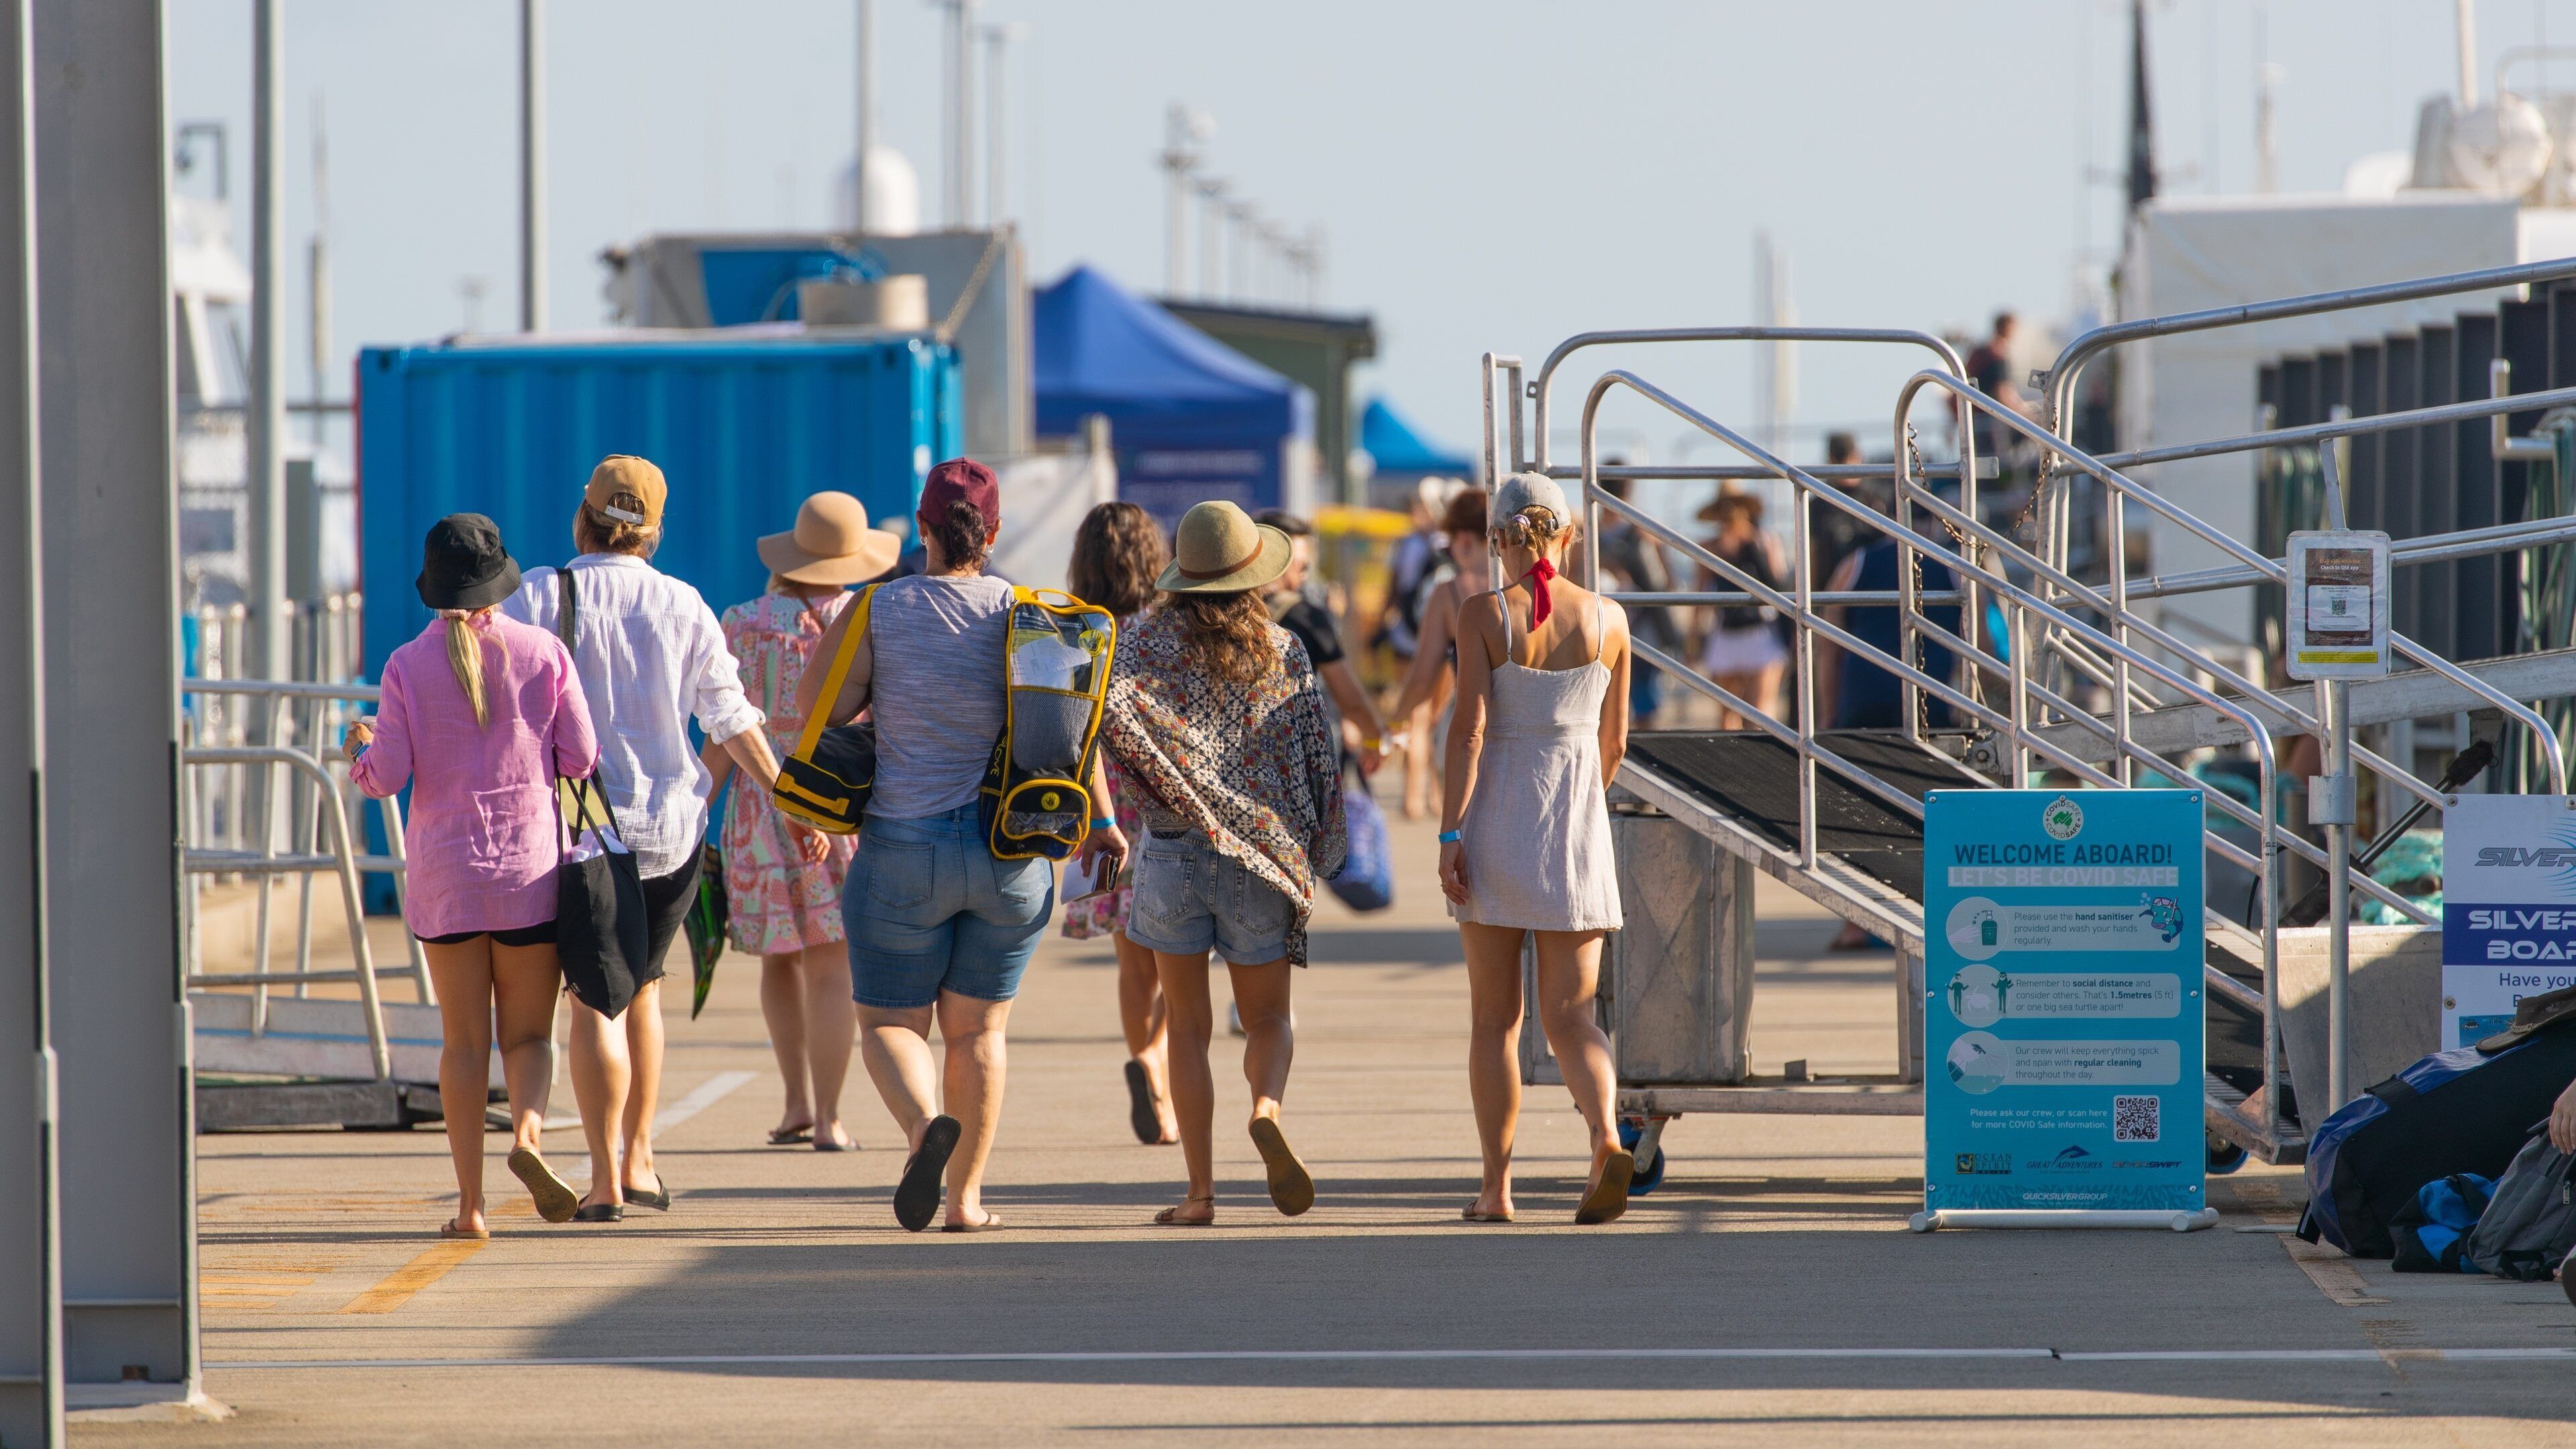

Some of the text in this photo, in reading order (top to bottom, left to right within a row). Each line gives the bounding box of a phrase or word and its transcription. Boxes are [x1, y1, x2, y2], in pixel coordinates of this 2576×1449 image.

[1954, 844, 2172, 864] WELCOME ABOARD!
[1949, 867, 2178, 887] LET'S BE COVID SAFE
[2014, 912, 2041, 920] Please
[2060, 912, 2074, 920] the
[2076, 912, 2096, 920] hand
[2098, 912, 2134, 920] sanitiser
[2468, 910, 2576, 930] SILVER
[2014, 924, 2138, 934] provided and wash your hands
[2014, 936, 2053, 946] regularly.
[2016, 979, 2060, 987] Remember
[2072, 979, 2097, 987] social
[2099, 979, 2133, 987] distance
[2135, 979, 2151, 987] and
[2500, 973, 2541, 987] Have
[2154, 991, 2163, 1000] (5
[2164, 991, 2174, 1000] ft)
[2044, 1003, 2057, 1012] big
[2075, 1003, 2097, 1011] turtle
[2100, 1003, 2123, 1012] apart!
[2015, 1046, 2031, 1055] Our
[2054, 1046, 2069, 1055] will
[2072, 1046, 2091, 1056] keep
[2093, 1046, 2136, 1057] everything
[2138, 1046, 2159, 1056] spick
[2015, 1059, 2141, 1068] and span with regular cleaning
[2015, 1071, 2061, 1080] throughout
[2078, 1071, 2094, 1079] day.
[2057, 1161, 2103, 1169] ADVENTURES
